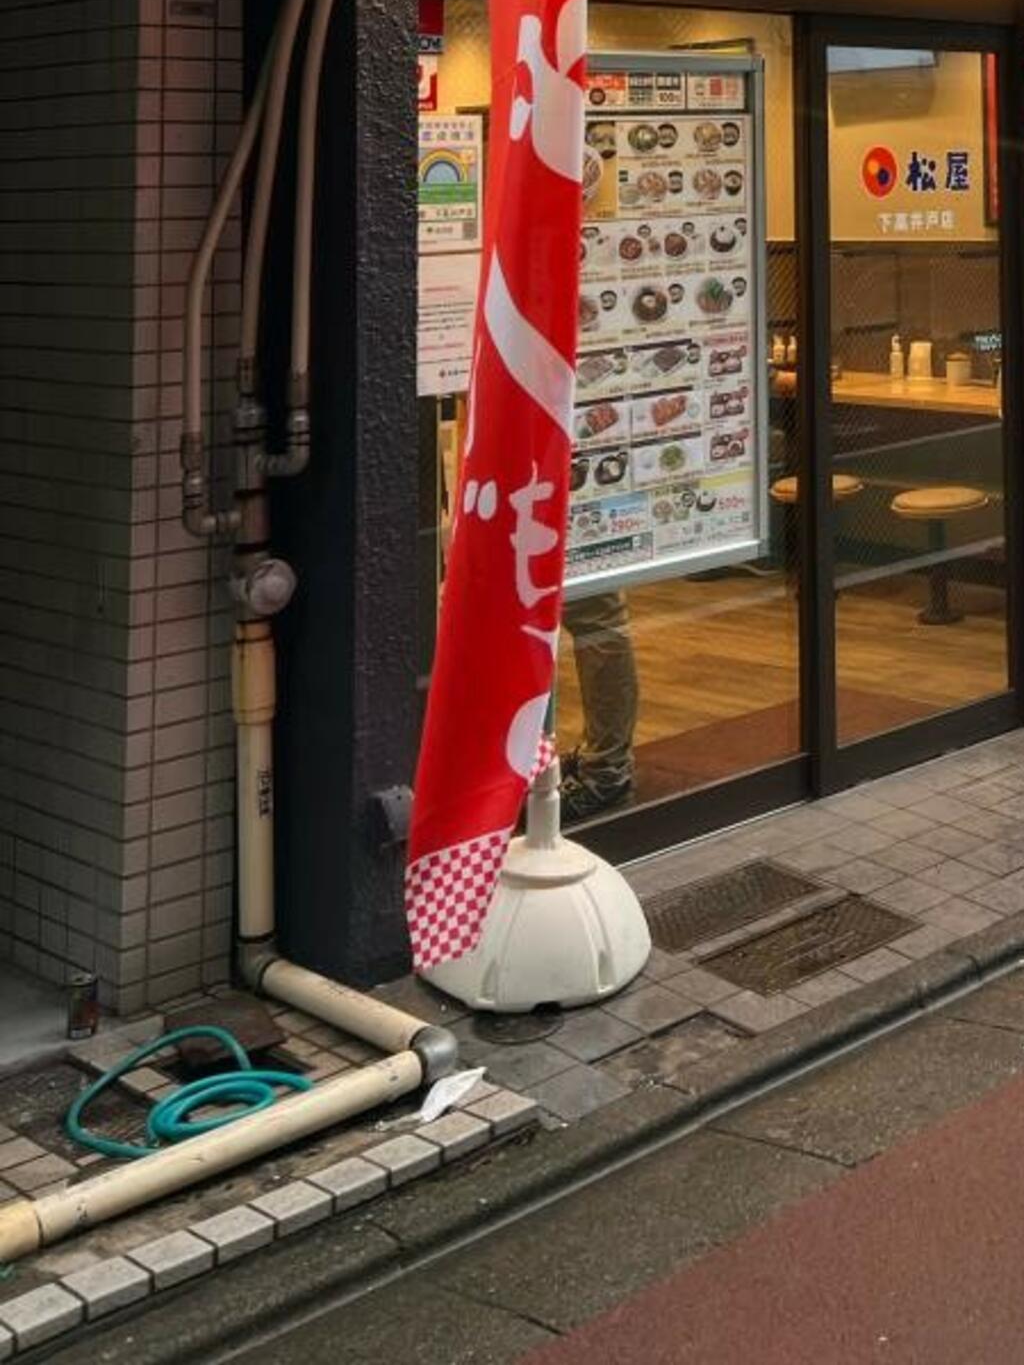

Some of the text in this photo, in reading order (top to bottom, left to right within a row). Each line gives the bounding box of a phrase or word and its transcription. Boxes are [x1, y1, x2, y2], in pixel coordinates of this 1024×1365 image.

[906, 151, 970, 192] 松屋
[877, 211, 955, 234] 下高井戸店
